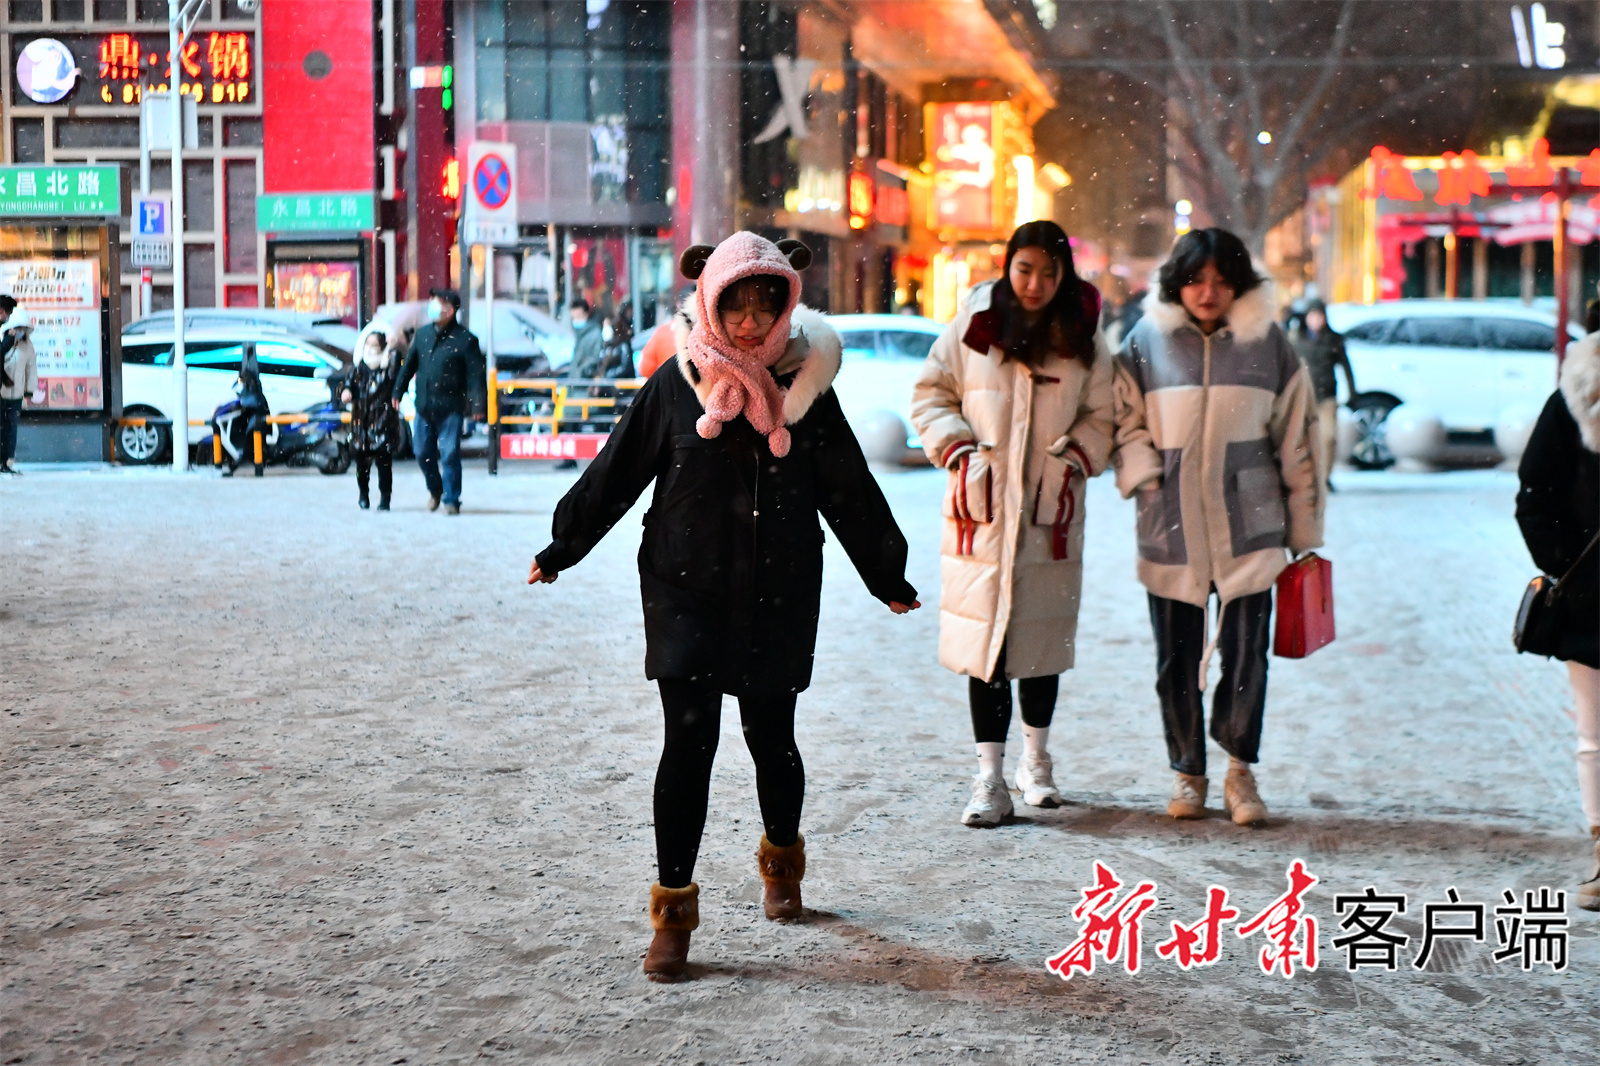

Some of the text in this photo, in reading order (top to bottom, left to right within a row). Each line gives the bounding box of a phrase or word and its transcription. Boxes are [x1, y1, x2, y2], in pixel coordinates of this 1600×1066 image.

[144, 203, 160, 232] P
[272, 197, 358, 217] 永昌北路
